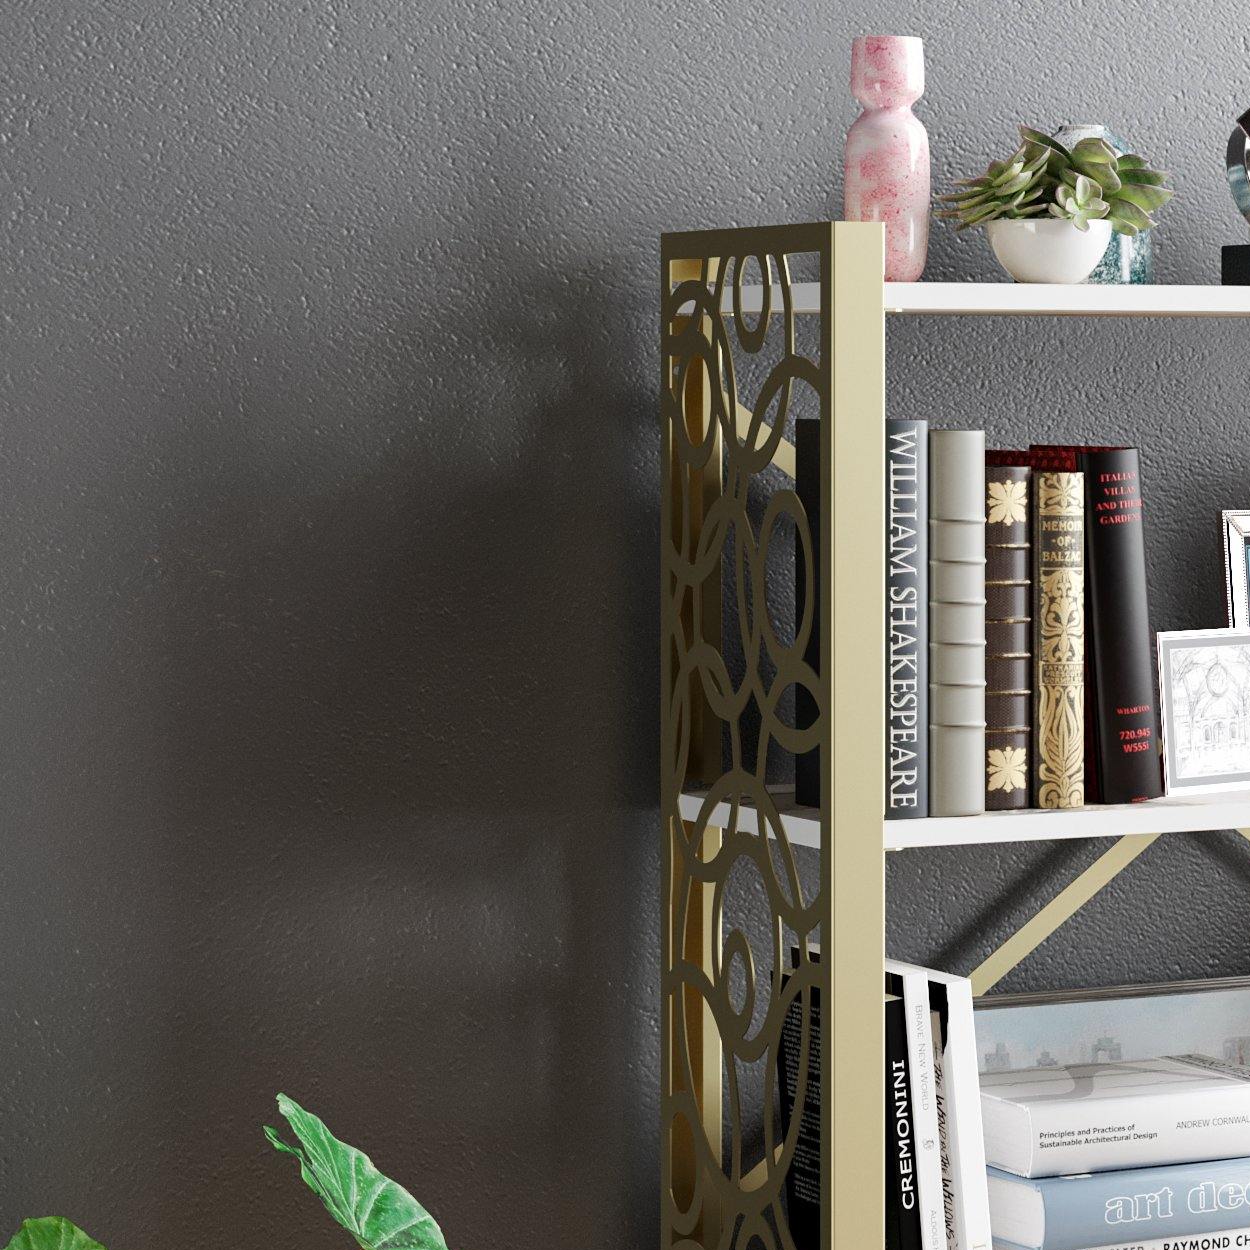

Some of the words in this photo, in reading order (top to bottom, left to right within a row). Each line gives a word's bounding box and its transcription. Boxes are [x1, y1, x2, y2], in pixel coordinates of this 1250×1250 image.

[889, 431, 918, 577] WILLIAM
[1096, 501, 1117, 511] AND
[1042, 520, 1083, 531] MEMOIR
[1042, 551, 1082, 562] BALZAC
[889, 586, 918, 809] SHAKESPEARE
[1119, 728, 1151, 741] 720.945
[914, 1005, 925, 1039] BRAVE
[917, 1043, 927, 1067] NEW
[920, 1072, 930, 1111] WORLD
[936, 1095, 948, 1140] WIND
[1039, 1130, 1075, 1141] Principles
[1077, 1126, 1091, 1136] and
[1093, 1124, 1125, 1134] Practices
[1127, 1123, 1135, 1131] of
[1176, 1119, 1210, 1129] ANDREW
[892, 1060, 915, 1209] CREMONINI
[1039, 1138, 1082, 1149] Sustainable
[1084, 1133, 1132, 1145] Architectural
[1134, 1131, 1158, 1143] Design
[941, 1153, 951, 1174] THE
[942, 1178, 956, 1241] WILLOWS
[1105, 1188, 1174, 1225] art
[930, 1210, 939, 1245] ALDOUS
